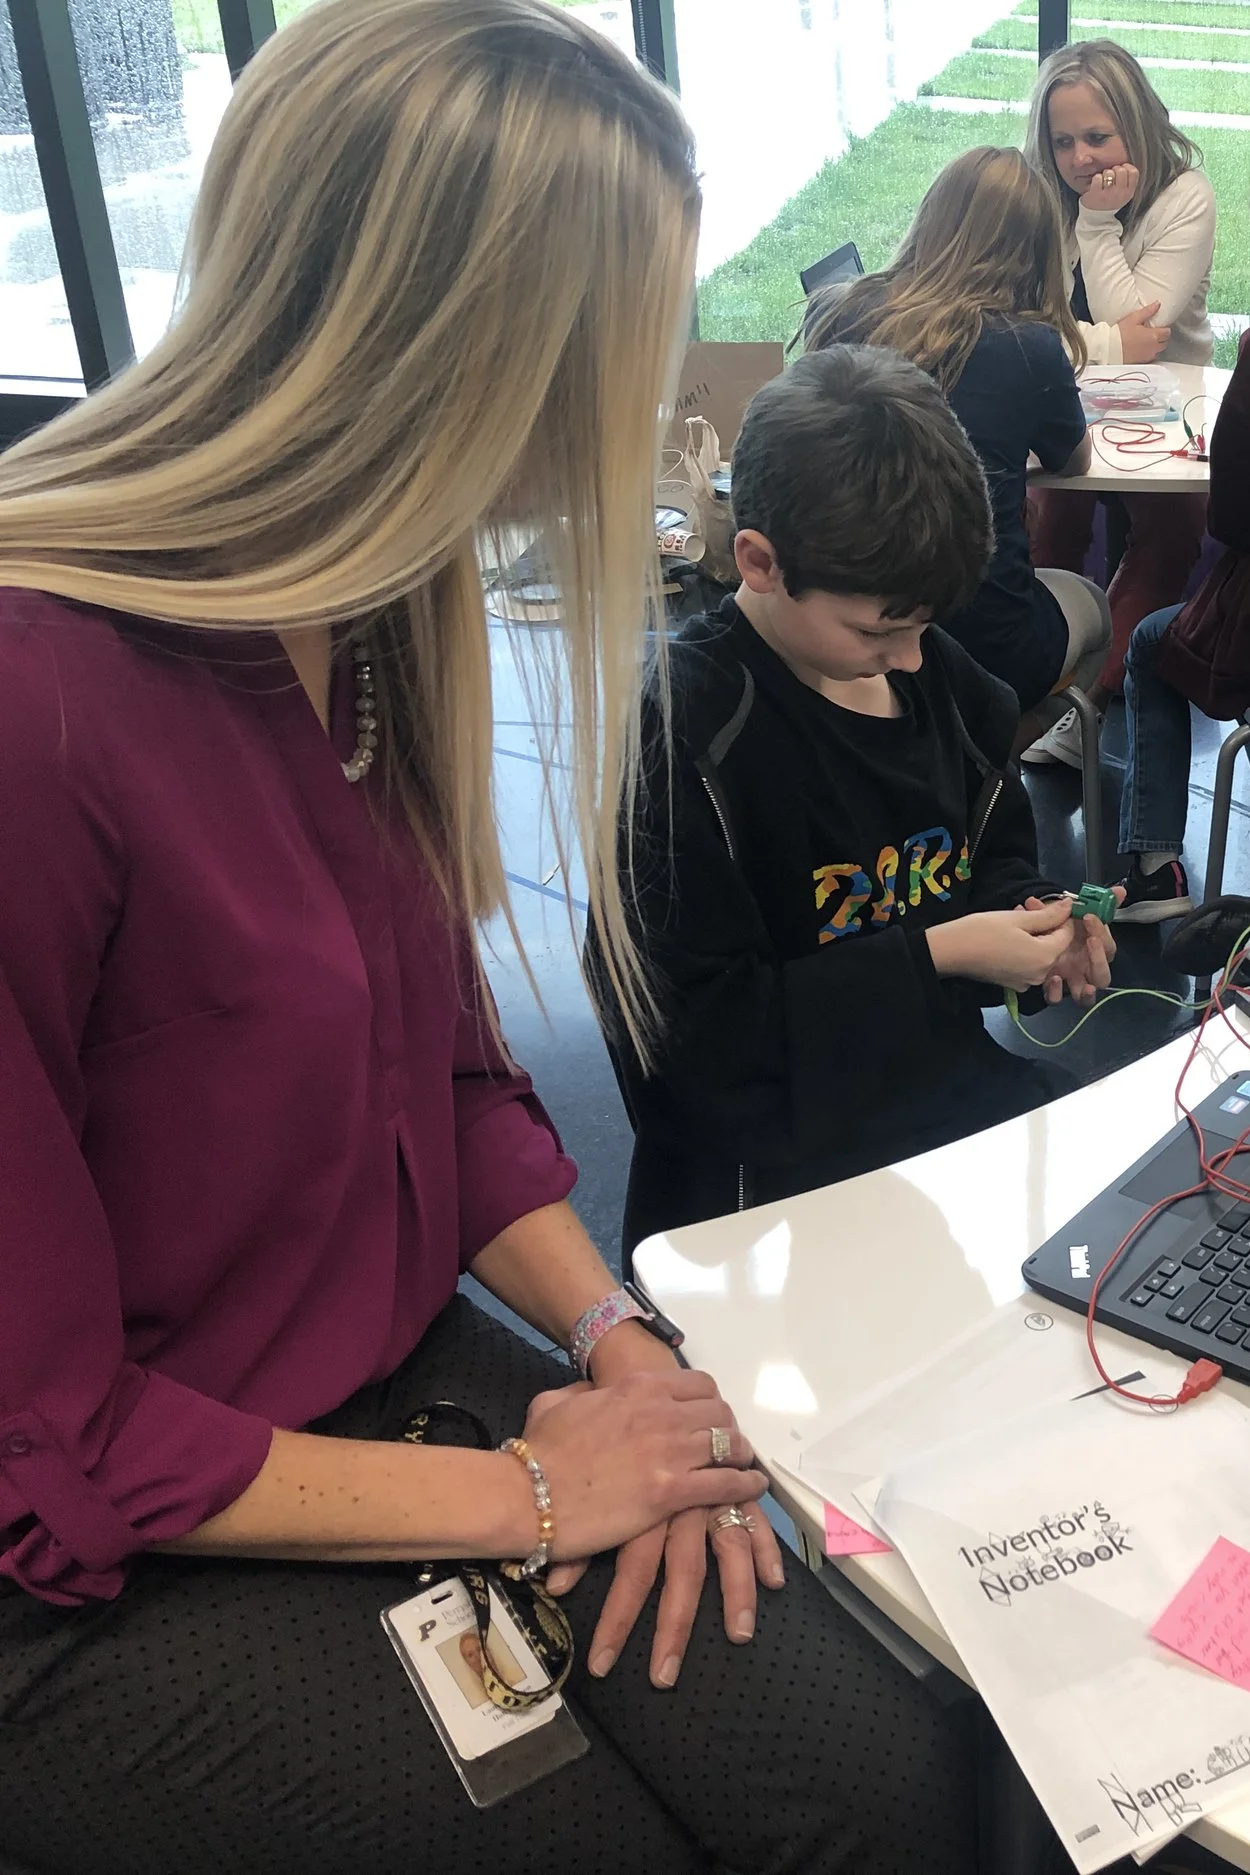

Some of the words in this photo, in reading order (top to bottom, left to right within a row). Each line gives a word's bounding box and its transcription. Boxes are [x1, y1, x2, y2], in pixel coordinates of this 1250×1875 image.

[960, 1503, 1112, 1569] Inventor's
[979, 1535, 1134, 1603] Notebook
[418, 1618, 438, 1642] P
[1107, 1766, 1202, 1823] Name:
